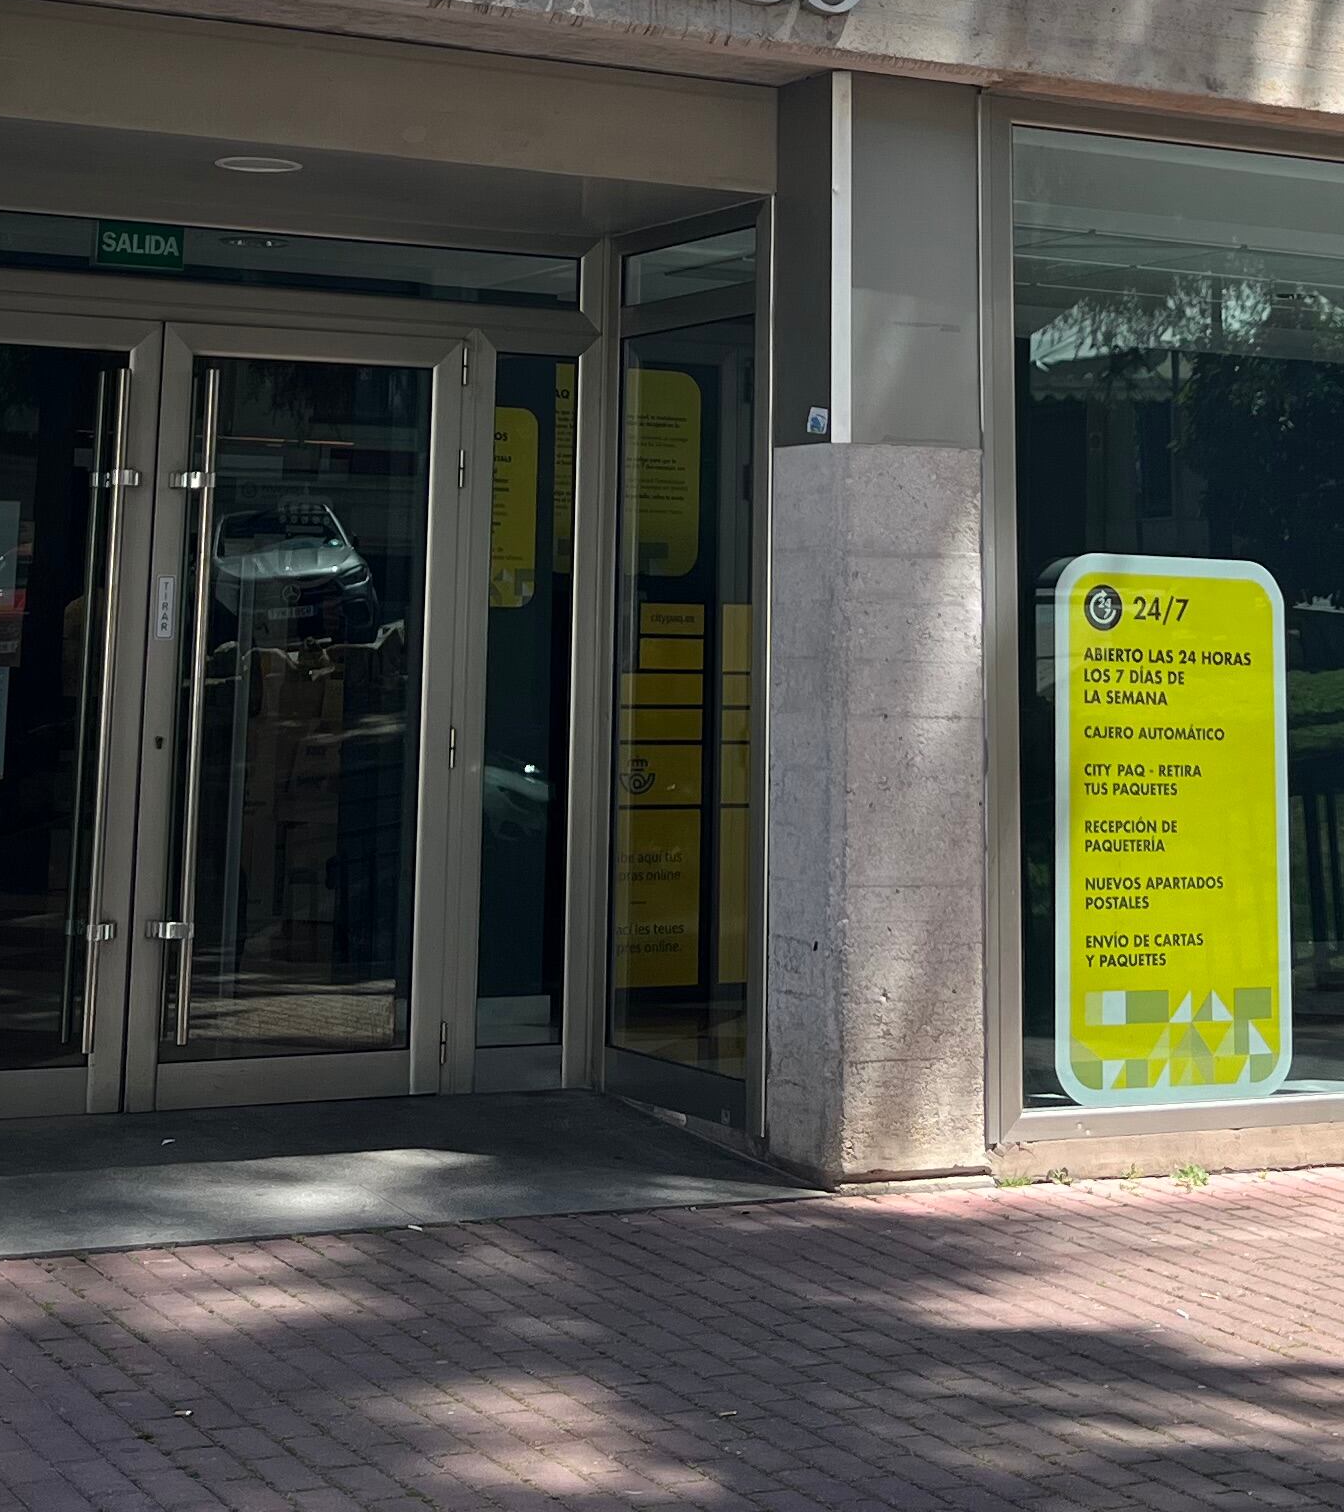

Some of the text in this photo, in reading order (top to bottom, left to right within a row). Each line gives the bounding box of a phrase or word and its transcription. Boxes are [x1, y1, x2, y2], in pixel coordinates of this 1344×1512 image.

[102, 231, 180, 257] SALIDA
[160, 581, 169, 631] TIRAR
[1133, 596, 1189, 625] 24/7
[1084, 648, 1251, 666] ABIERTO LAS 24 HORAS
[1084, 665, 1185, 685] LOS 7 DÍAS DE
[1084, 690, 1168, 706] LA SEMANA
[1084, 724, 1225, 741] CAJERO AUTOMÁTICO
[1084, 763, 1111, 777] CITY
[1117, 764, 1145, 778] PAQ
[1158, 765, 1202, 777] RETIRA
[1084, 782, 1178, 796] TUS PAQUETES
[1084, 816, 1178, 834] RECEPCIÓN DE
[1084, 835, 1165, 853] PAQUETERÍA
[646, 868, 681, 881] online
[1085, 876, 1224, 890] NUEVOS APARTADOS
[1085, 896, 1150, 910] POSTALES
[1085, 931, 1203, 949] ENVÍO DE CARTAS
[1086, 953, 1167, 968] Y PAQUETES
